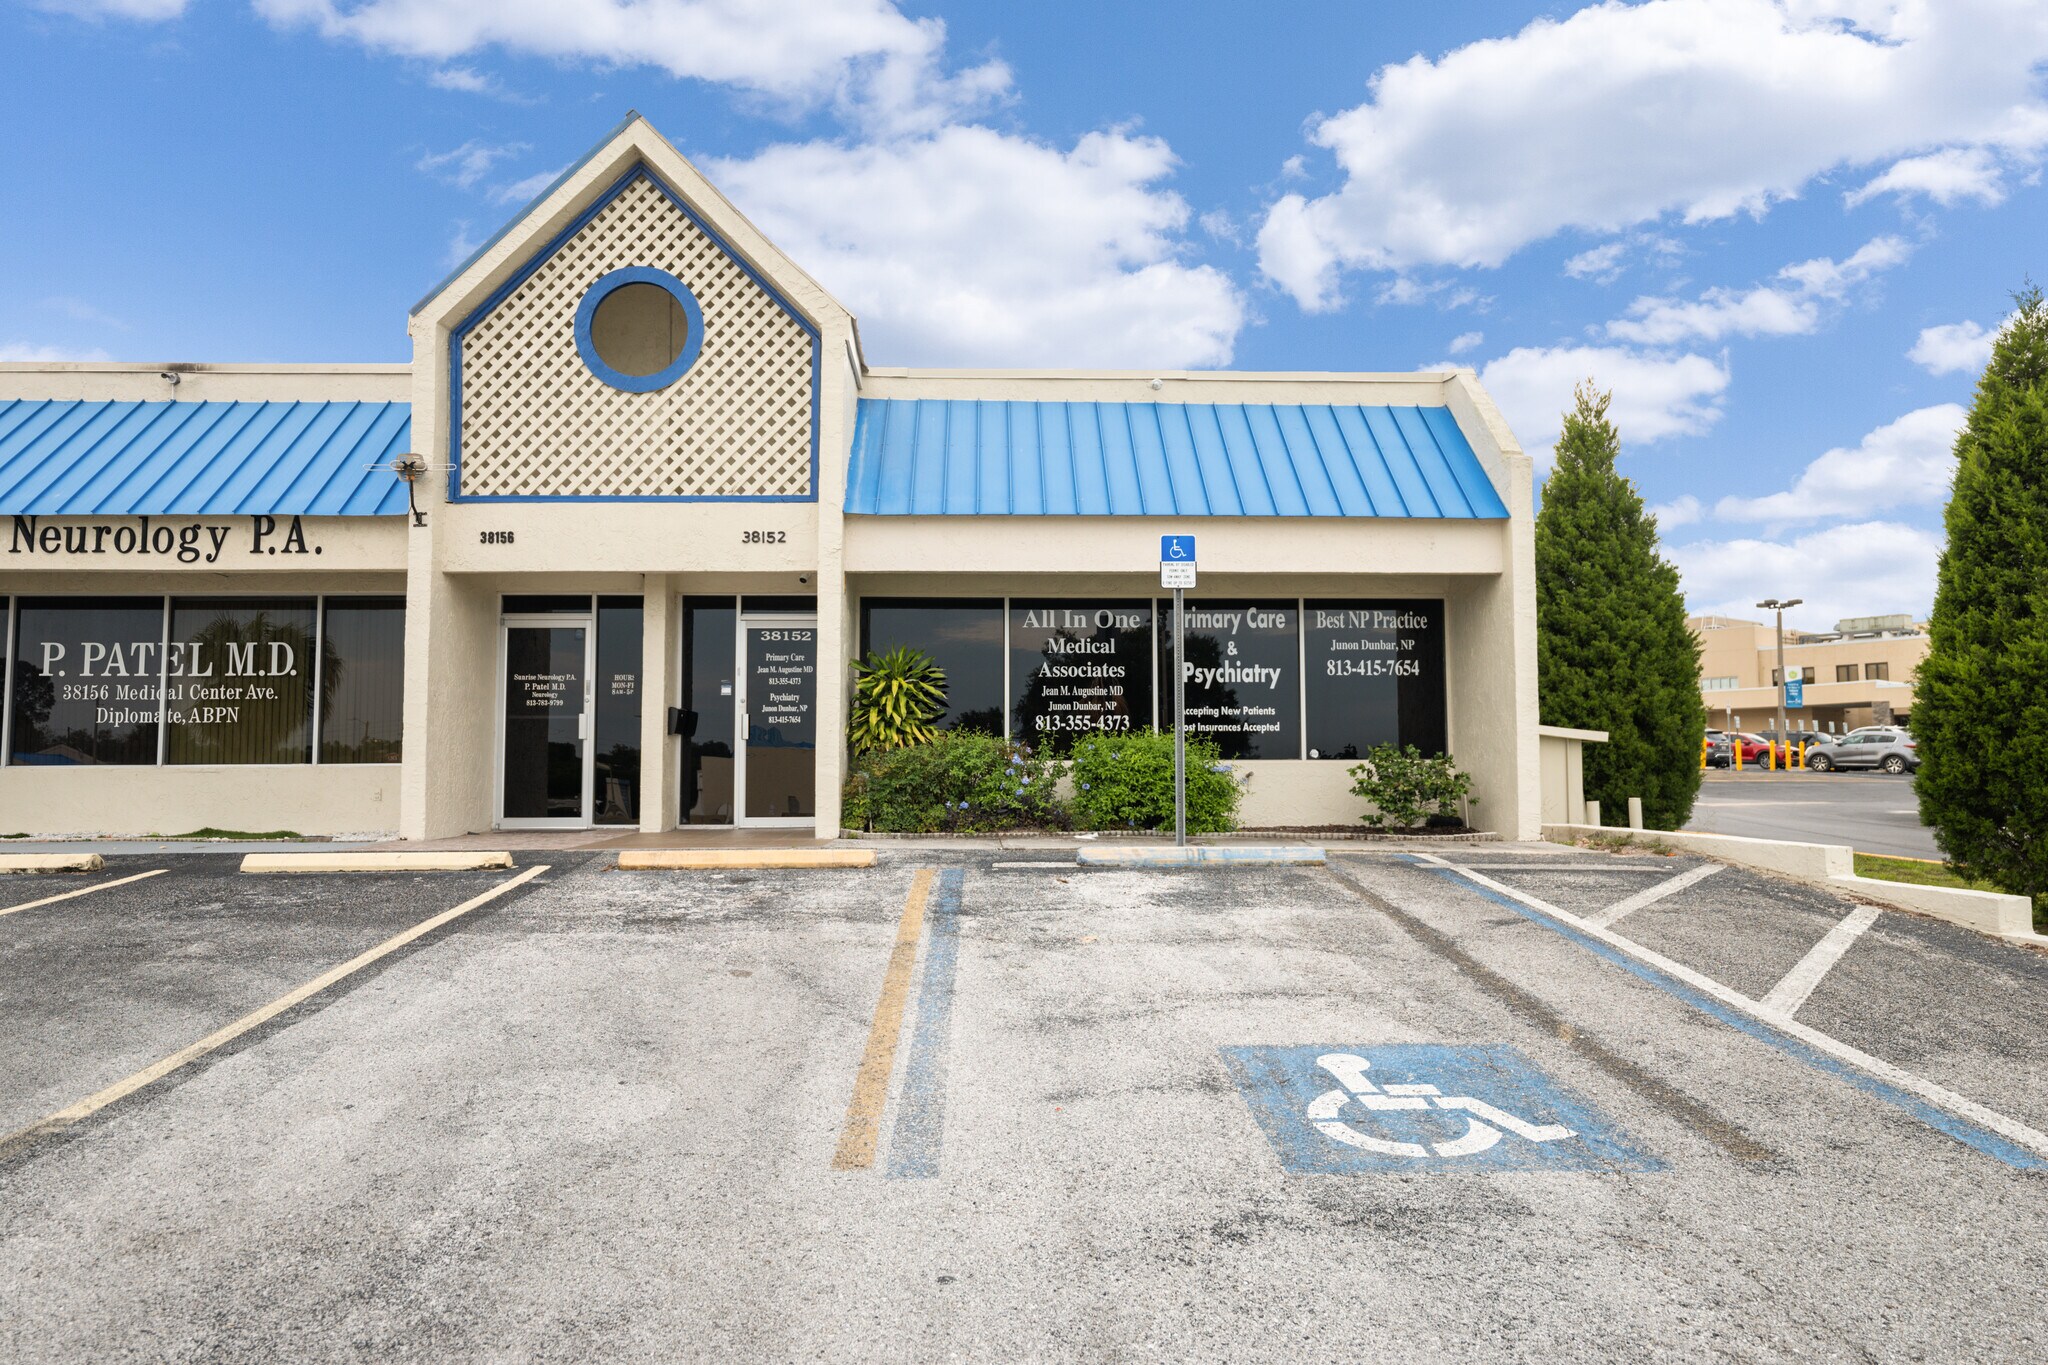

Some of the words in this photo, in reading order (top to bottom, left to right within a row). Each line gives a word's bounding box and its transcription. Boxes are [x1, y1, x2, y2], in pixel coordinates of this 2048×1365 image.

[8, 514, 231, 563] Neurology
[249, 514, 323, 555] P.A.
[479, 531, 515, 545] 38156
[741, 531, 787, 544] 38152
[1022, 609, 1056, 628] All
[1063, 609, 1087, 628] In
[1094, 609, 1141, 629] One
[1184, 605, 1242, 635] rimary
[1246, 607, 1286, 629] Care
[1316, 611, 1346, 629] Best
[1348, 611, 1370, 629] NP
[1373, 611, 1428, 629] Practice
[760, 630, 812, 641] 38152
[1047, 638, 1116, 654] Medical
[1227, 641, 1238, 656] &
[1330, 640, 1359, 651] Junon
[1361, 640, 1399, 652] Dunbar,
[1400, 640, 1416, 650] NP
[38, 642, 66, 677] P.
[79, 642, 213, 677] PATEL
[225, 641, 297, 677] M.D.
[765, 653, 789, 663] Primary
[790, 653, 805, 662] Care
[757, 666, 769, 674] Jean
[778, 666, 803, 675] Augustine
[1038, 661, 1126, 678] Associates
[1326, 659, 1420, 676] 813-415-7654
[537, 674, 565, 682] Neurology
[1183, 660, 1281, 690] Psychiatry
[62, 684, 109, 700] 38156
[115, 684, 183, 700] Medical
[189, 684, 243, 700] Center
[245, 684, 279, 700] Ave.
[769, 693, 800, 703] Psychiatry
[1041, 685, 1059, 697] Jean
[1060, 685, 1071, 696] M.
[1072, 685, 1108, 698] Augustine
[1109, 685, 1124, 696] MD
[762, 705, 778, 713] Junon
[778, 705, 799, 713] Dunbar,
[1048, 701, 1071, 712] Junon
[1073, 701, 1104, 712] Dunbar,
[1105, 701, 1118, 711] NP
[1183, 706, 1219, 717] ccepting
[1221, 706, 1241, 716] New
[1243, 706, 1276, 716] Patients
[188, 707, 240, 724] ABPN
[1035, 715, 1130, 731] 813-355-4373
[1184, 722, 1196, 732] ost
[1198, 722, 1241, 732] Insurances
[1243, 721, 1280, 733] Accepted
